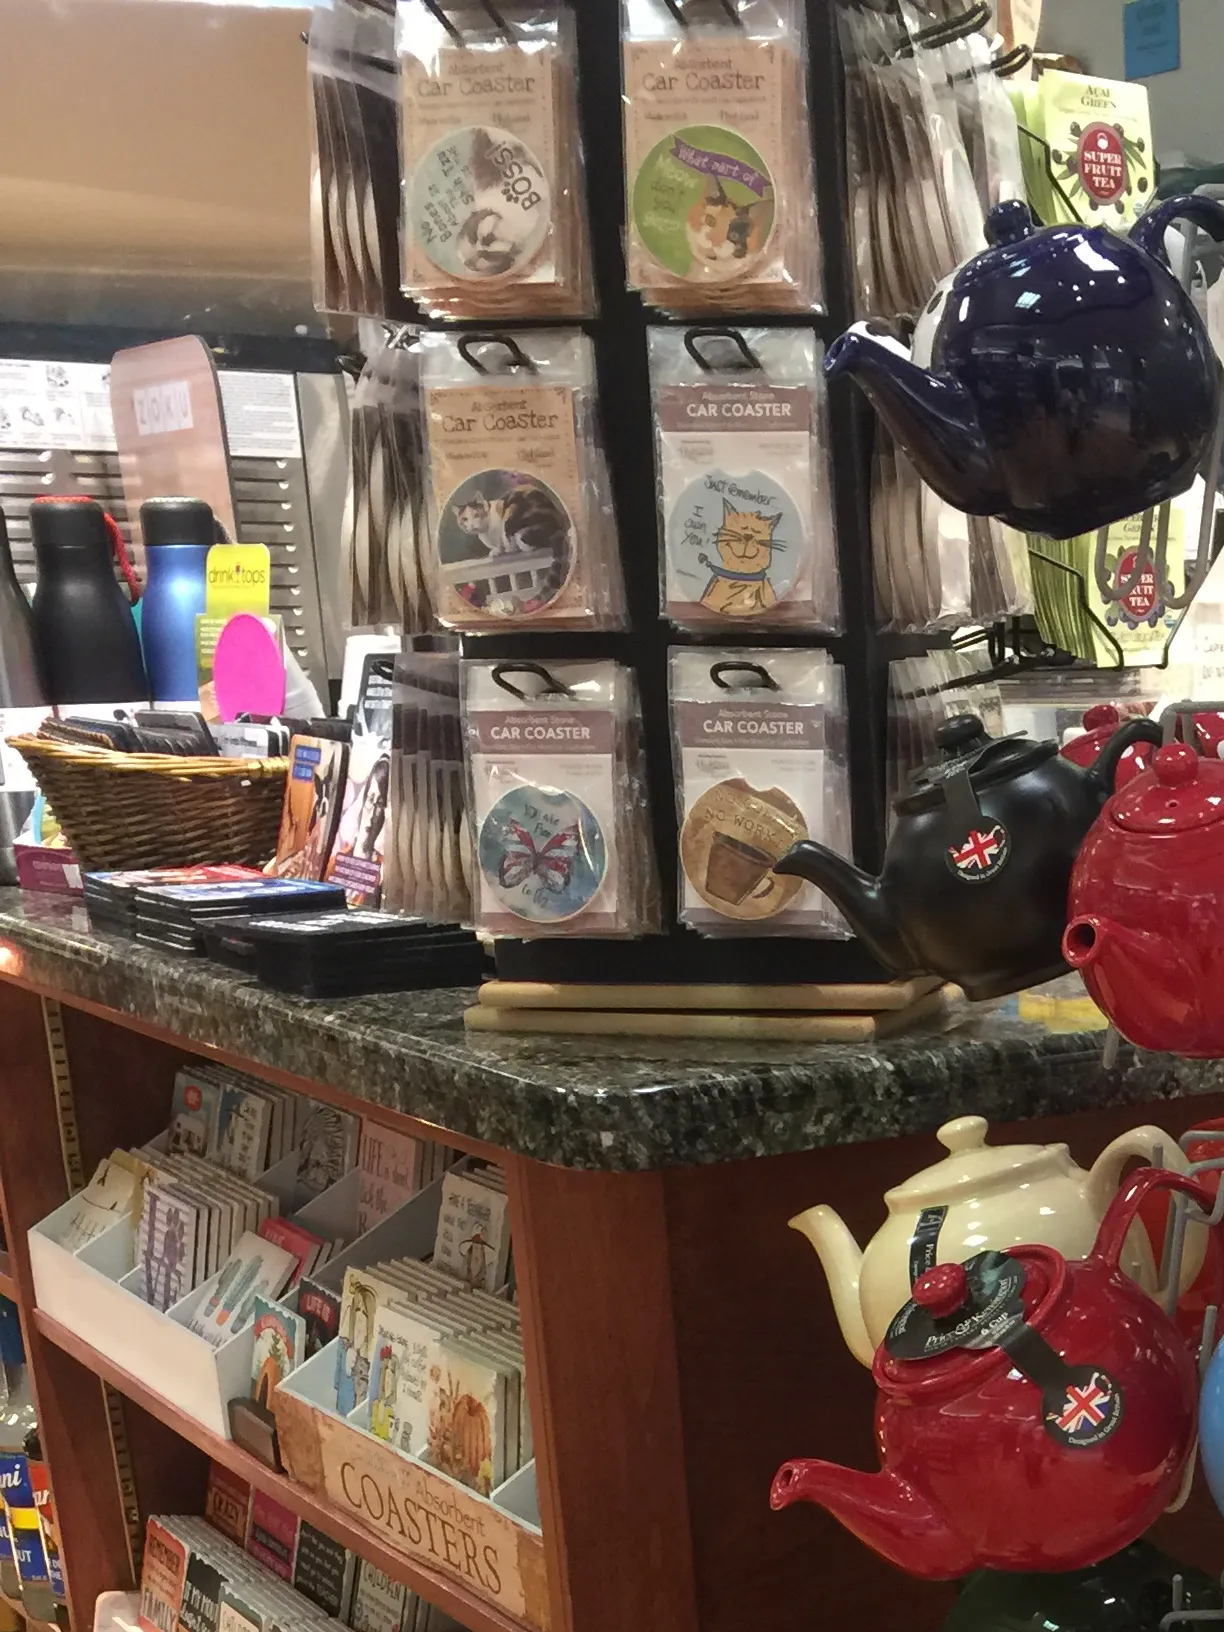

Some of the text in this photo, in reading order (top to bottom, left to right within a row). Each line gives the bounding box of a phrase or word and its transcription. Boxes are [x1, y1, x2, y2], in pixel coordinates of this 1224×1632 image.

[418, 75, 536, 97] Car Coaster
[642, 70, 766, 91] Car Coaster
[1084, 151, 1122, 165] SUPER
[1084, 163, 1122, 177] FRUIT
[1092, 176, 1116, 189] TEA
[686, 403, 792, 418] CAR COASTER
[442, 410, 558, 432] Car Coaster
[1129, 596, 1150, 607] TEA
[490, 726, 591, 740] CAR COASTER
[703, 720, 804, 735] CAR COASTER
[989, 1312, 1009, 1328] Cup
[416, 1474, 486, 1538] Absorbent
[340, 1461, 502, 1595] COASTERS
